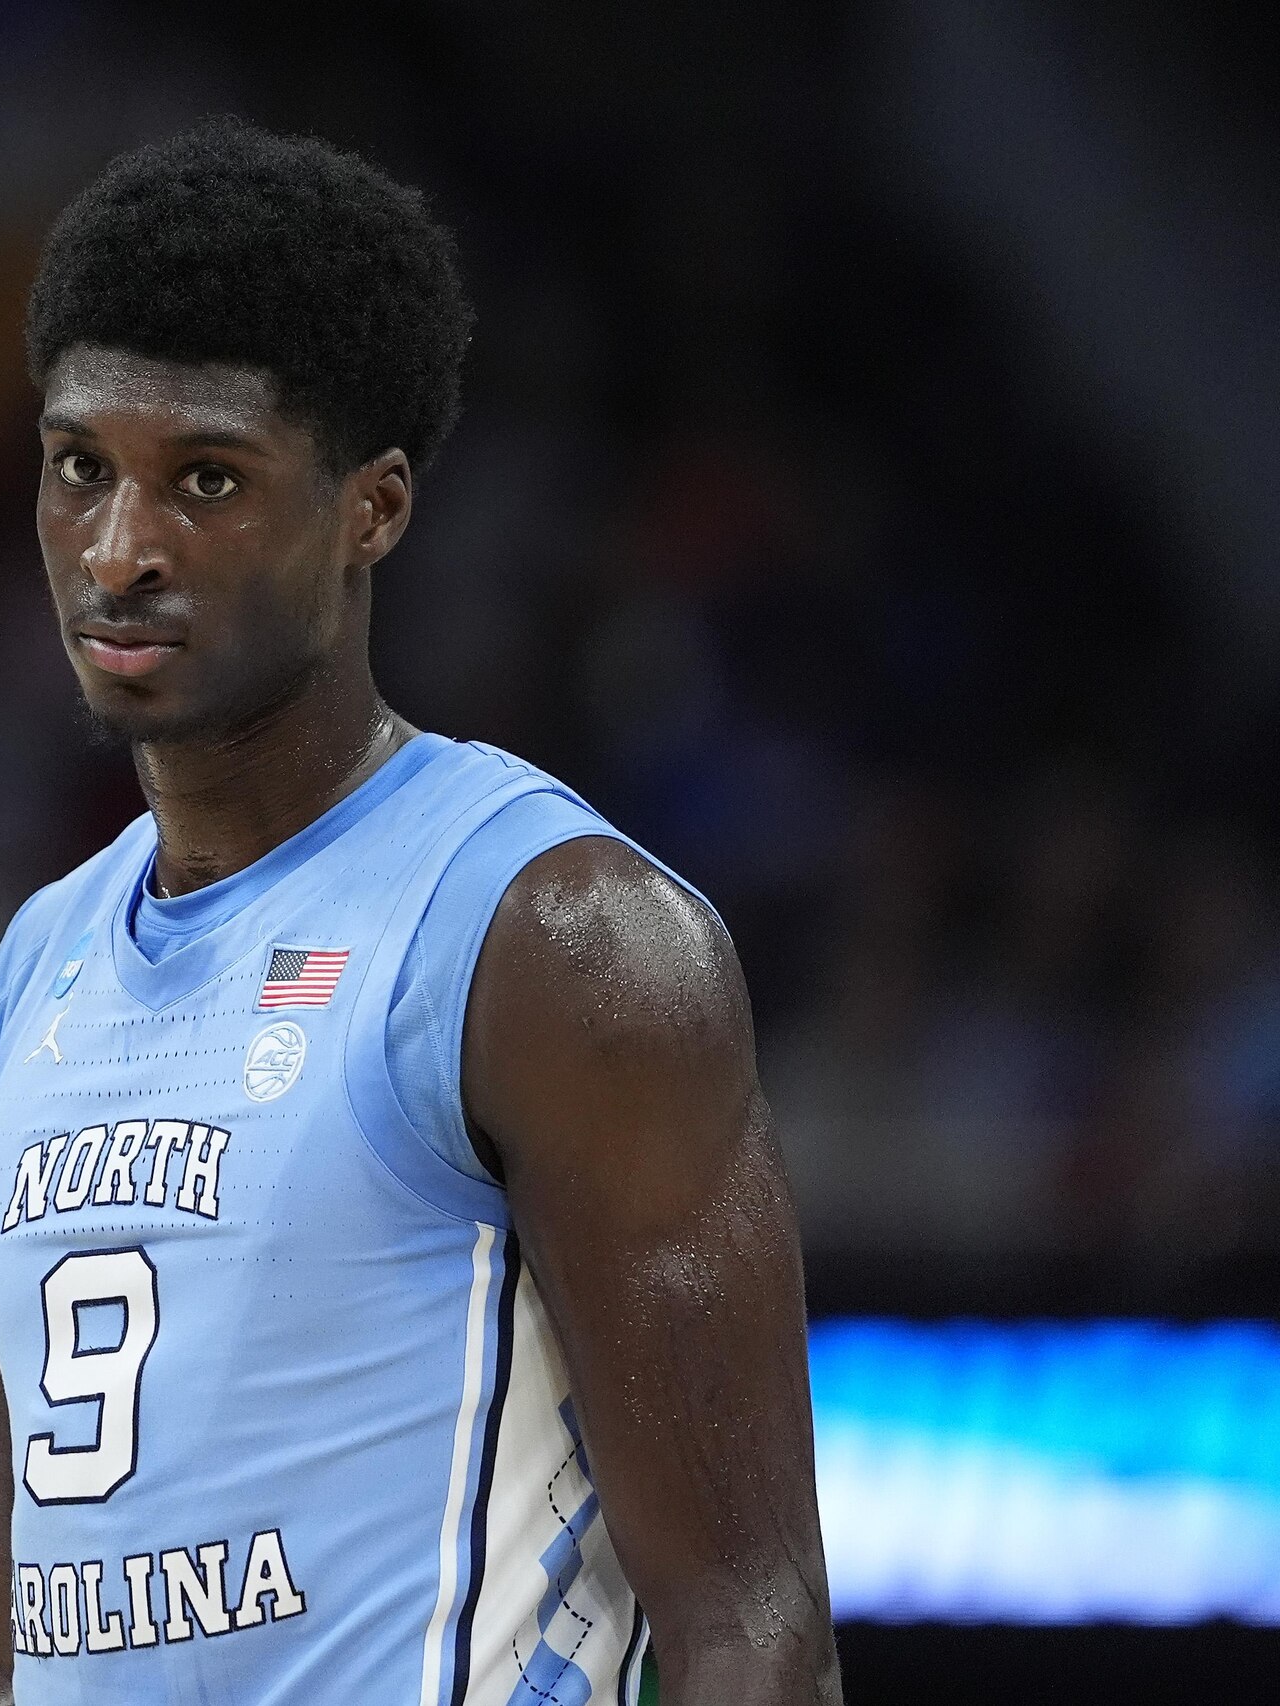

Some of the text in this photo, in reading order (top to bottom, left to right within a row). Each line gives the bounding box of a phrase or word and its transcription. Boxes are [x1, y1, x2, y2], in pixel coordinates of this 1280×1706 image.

[253, 1049, 302, 1068] ACC
[1, 1119, 231, 1234] NORTH
[22, 1245, 160, 1507] 9
